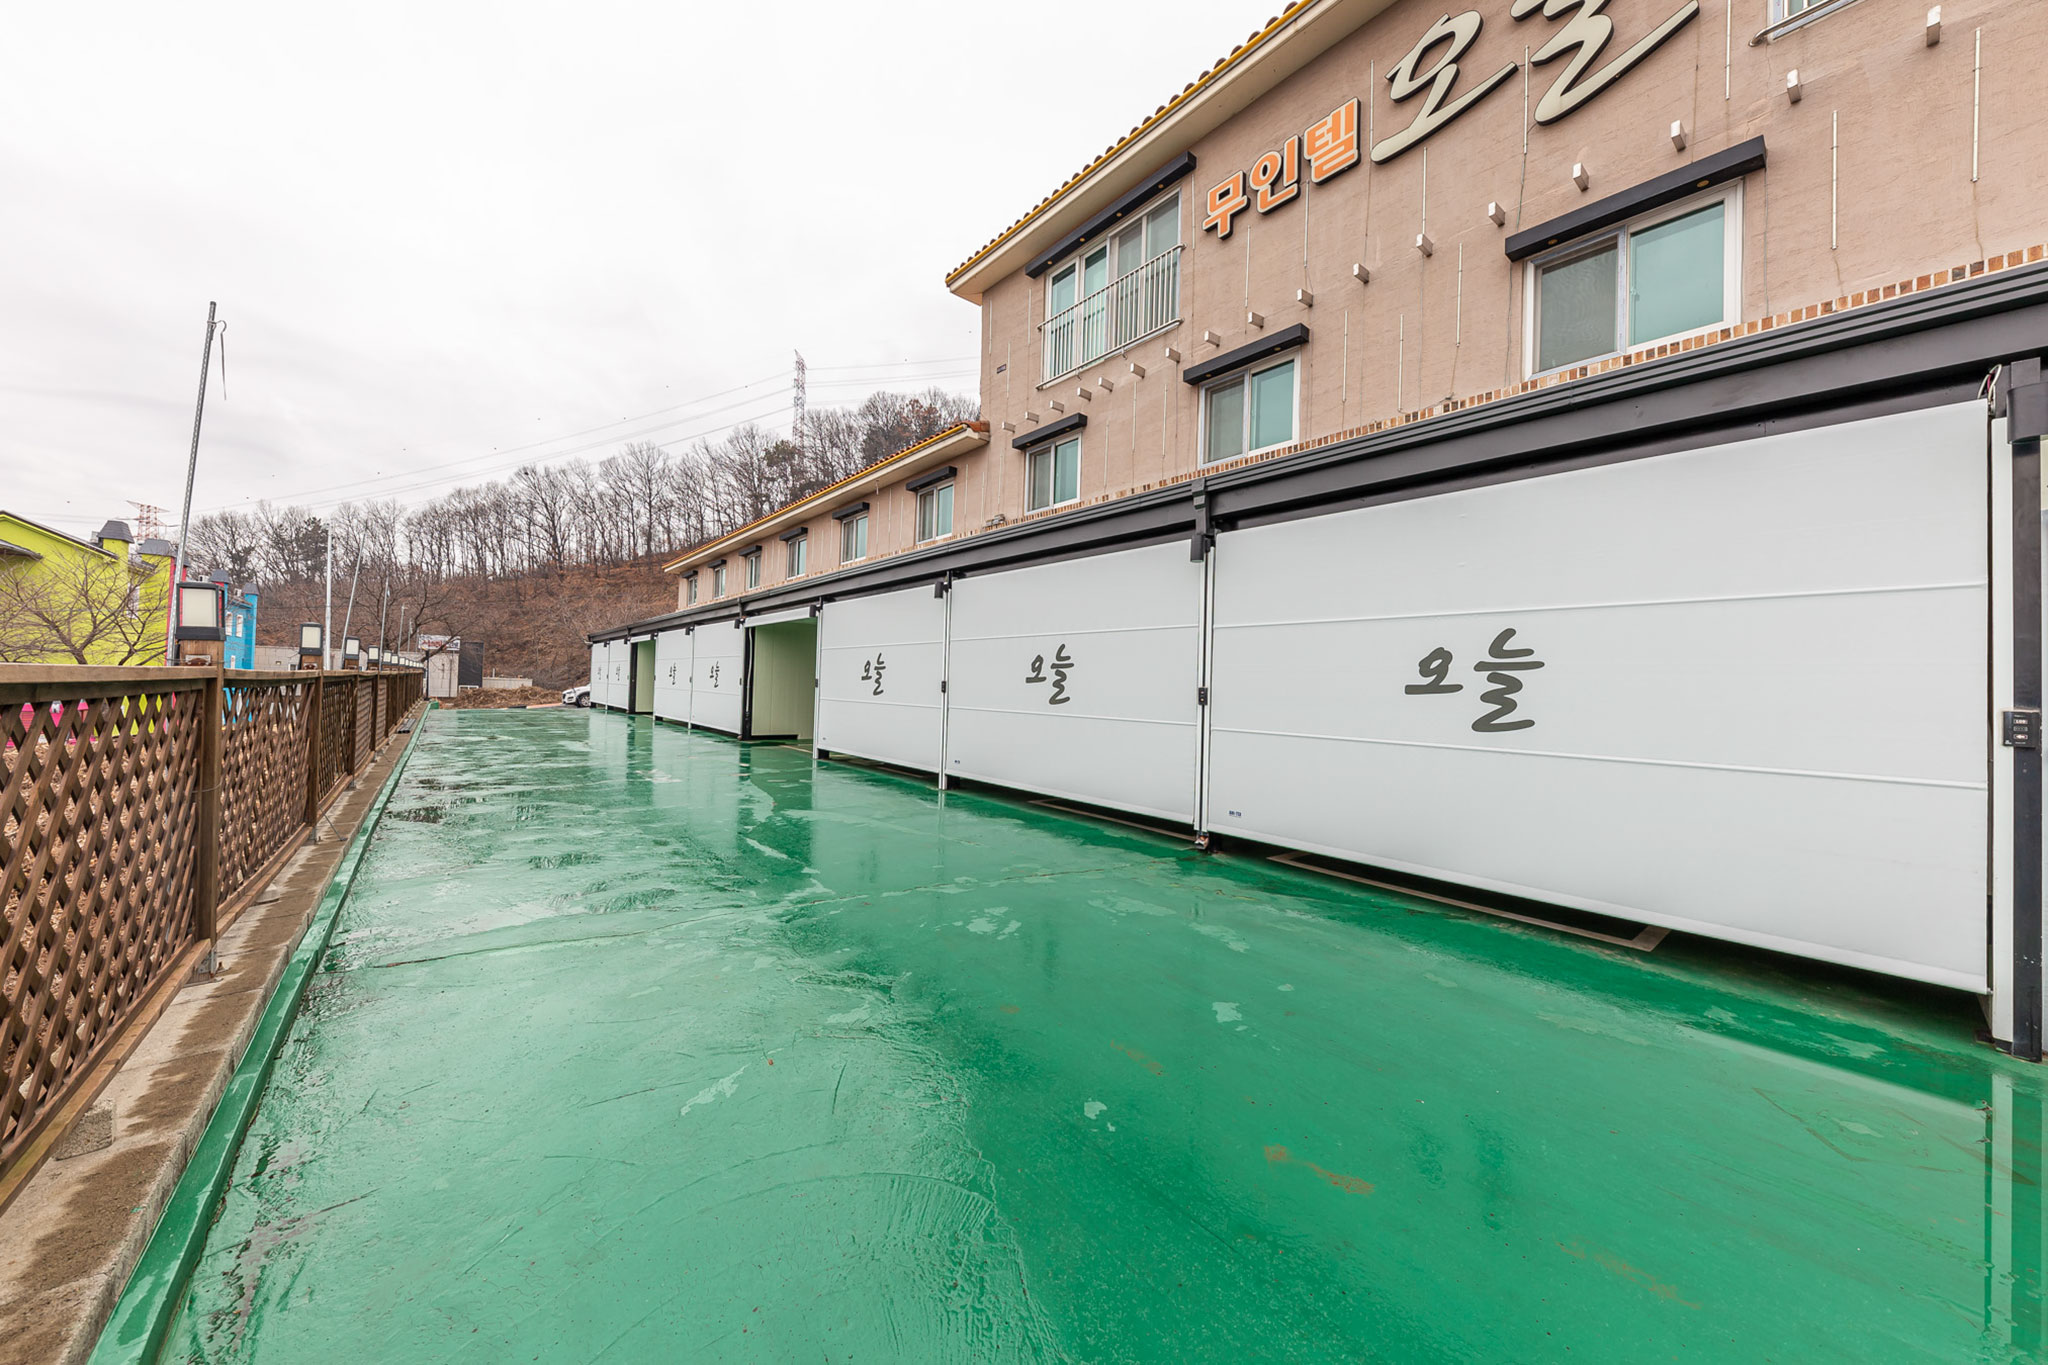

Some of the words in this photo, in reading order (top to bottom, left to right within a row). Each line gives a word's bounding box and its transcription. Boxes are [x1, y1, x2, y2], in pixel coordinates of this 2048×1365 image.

[1203, 97, 1361, 238] 무인텔
[861, 652, 886, 696] 오늘
[1025, 643, 1075, 706] 오늘
[1405, 627, 1546, 733] 오늘
